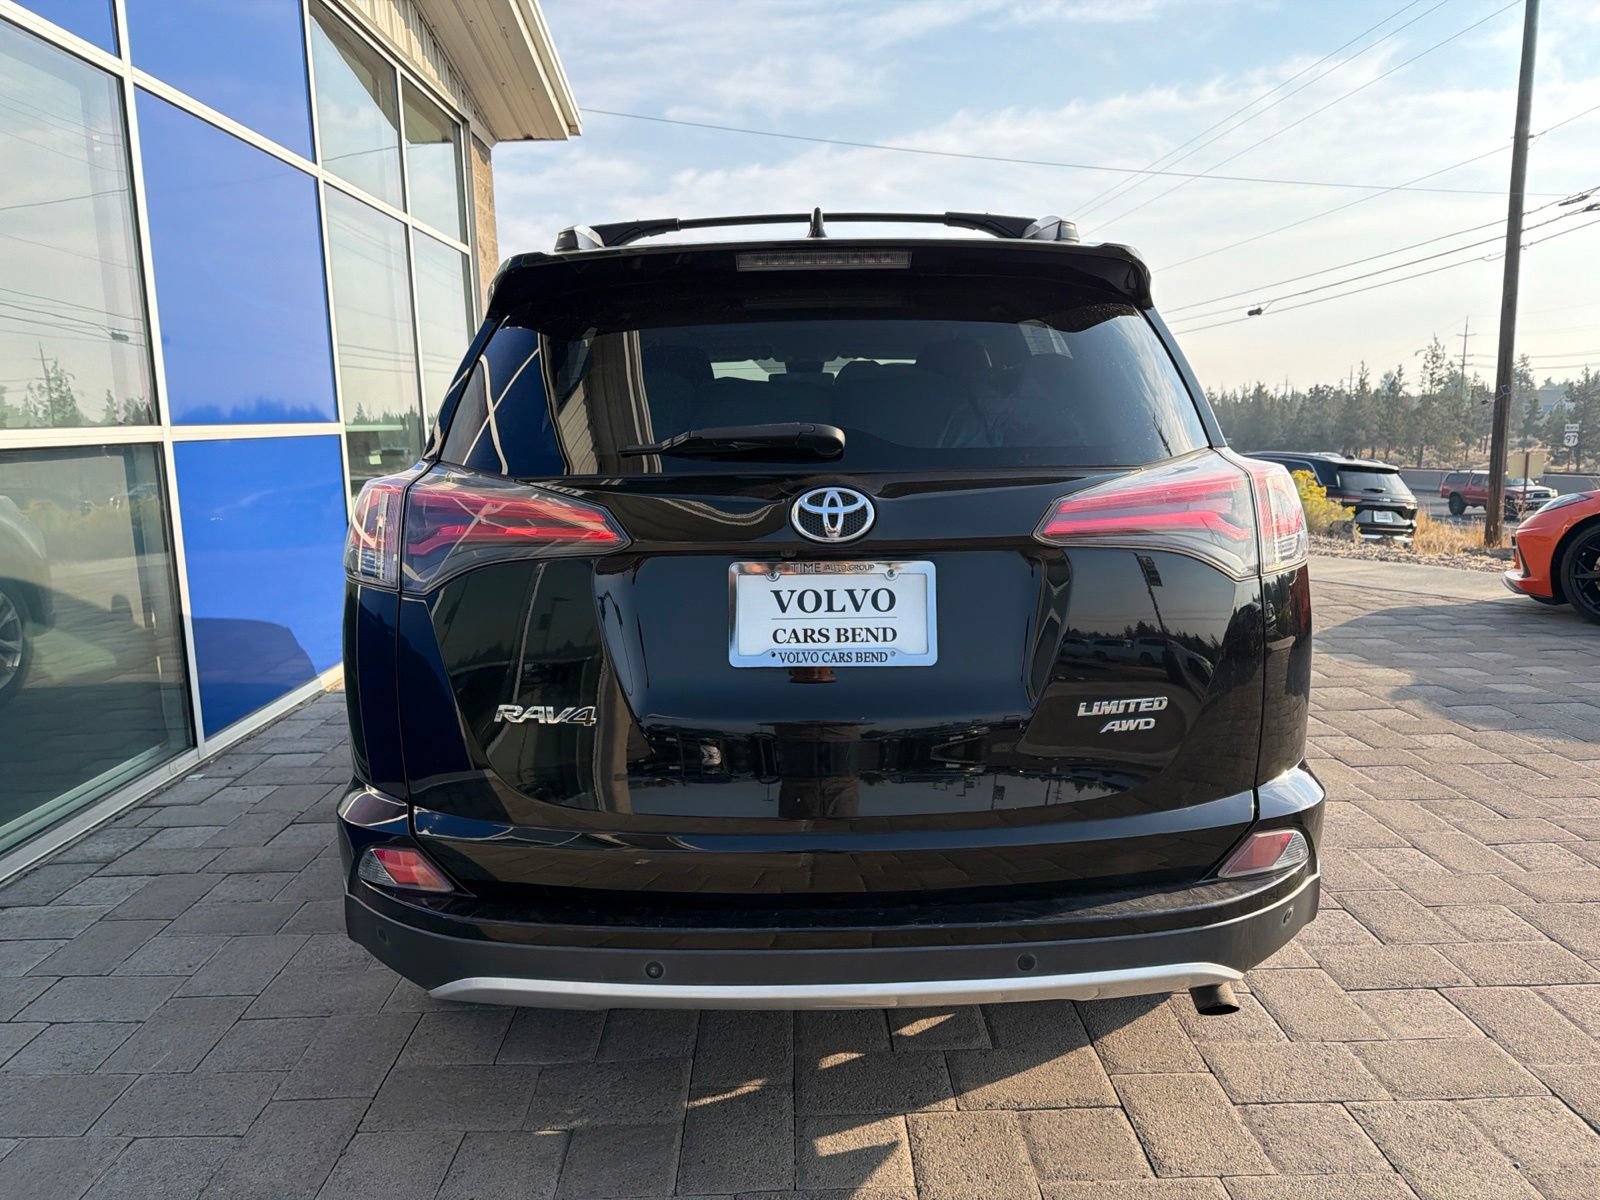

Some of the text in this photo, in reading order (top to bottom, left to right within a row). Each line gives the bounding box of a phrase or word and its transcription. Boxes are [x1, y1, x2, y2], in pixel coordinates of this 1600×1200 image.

[1566, 435, 1577, 444] 97
[790, 562, 875, 573] TIME AUTO GROUP
[770, 588, 897, 613] VOLVO
[772, 626, 897, 644] CARS BEND
[778, 650, 888, 664] VOLVO CARS BEND
[1077, 696, 1168, 717] LIMITED
[494, 704, 597, 726] RAV4
[1099, 718, 1156, 733] AWD
